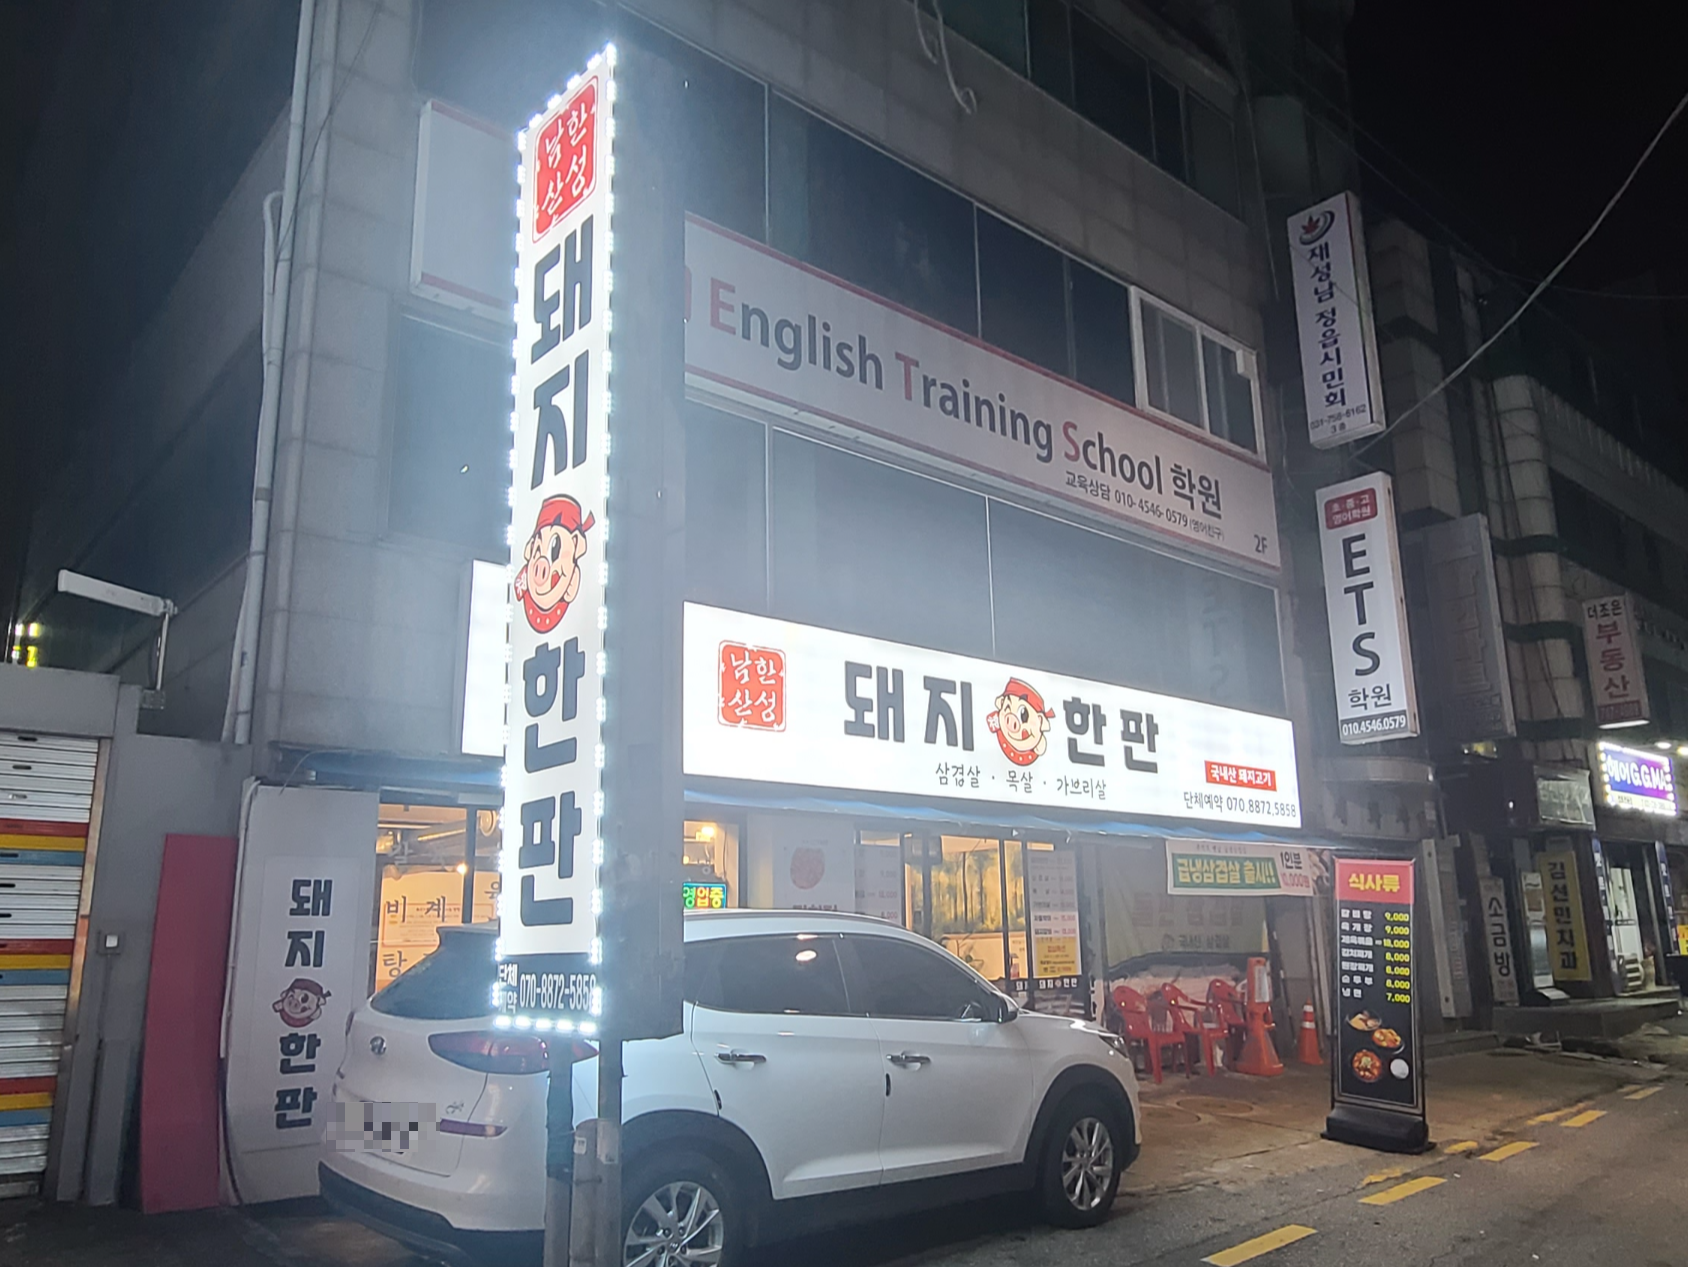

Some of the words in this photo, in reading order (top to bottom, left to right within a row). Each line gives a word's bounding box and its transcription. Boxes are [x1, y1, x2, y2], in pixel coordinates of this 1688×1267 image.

[545, 102, 587, 169] 남한
[541, 144, 587, 216] 산성
[531, 213, 594, 491] 돼지
[710, 277, 883, 391] English
[895, 352, 1053, 463] Training
[1062, 421, 1163, 494] School
[1170, 463, 1222, 519] 학원
[1065, 470, 1111, 501] 교육상담
[1253, 534, 1268, 554] 2F
[1341, 533, 1380, 677] ETS
[730, 651, 777, 684] 남한
[1596, 621, 1630, 699] 부동산
[728, 689, 777, 722] 산성
[844, 660, 975, 751] 돼지
[1063, 697, 1159, 773] 한판
[1348, 683, 1392, 711] 학원
[1342, 714, 1407, 737] 010.4546.0579
[519, 636, 586, 927] 한판
[935, 761, 981, 788] 삼겹살
[1006, 769, 1033, 793] 목살
[1057, 775, 1107, 800] 가브리살
[1210, 763, 1237, 783] 국내산
[1238, 768, 1272, 787] 돼지고기
[1183, 791, 1223, 813] 단체예약
[1226, 796, 1297, 818] 070.8872.5858
[682, 886, 725, 909] 영업중
[1348, 873, 1401, 893] 식사류
[284, 879, 333, 968] 돼지
[1488, 897, 1511, 977] 소금방
[274, 1032, 321, 1130] 한판
